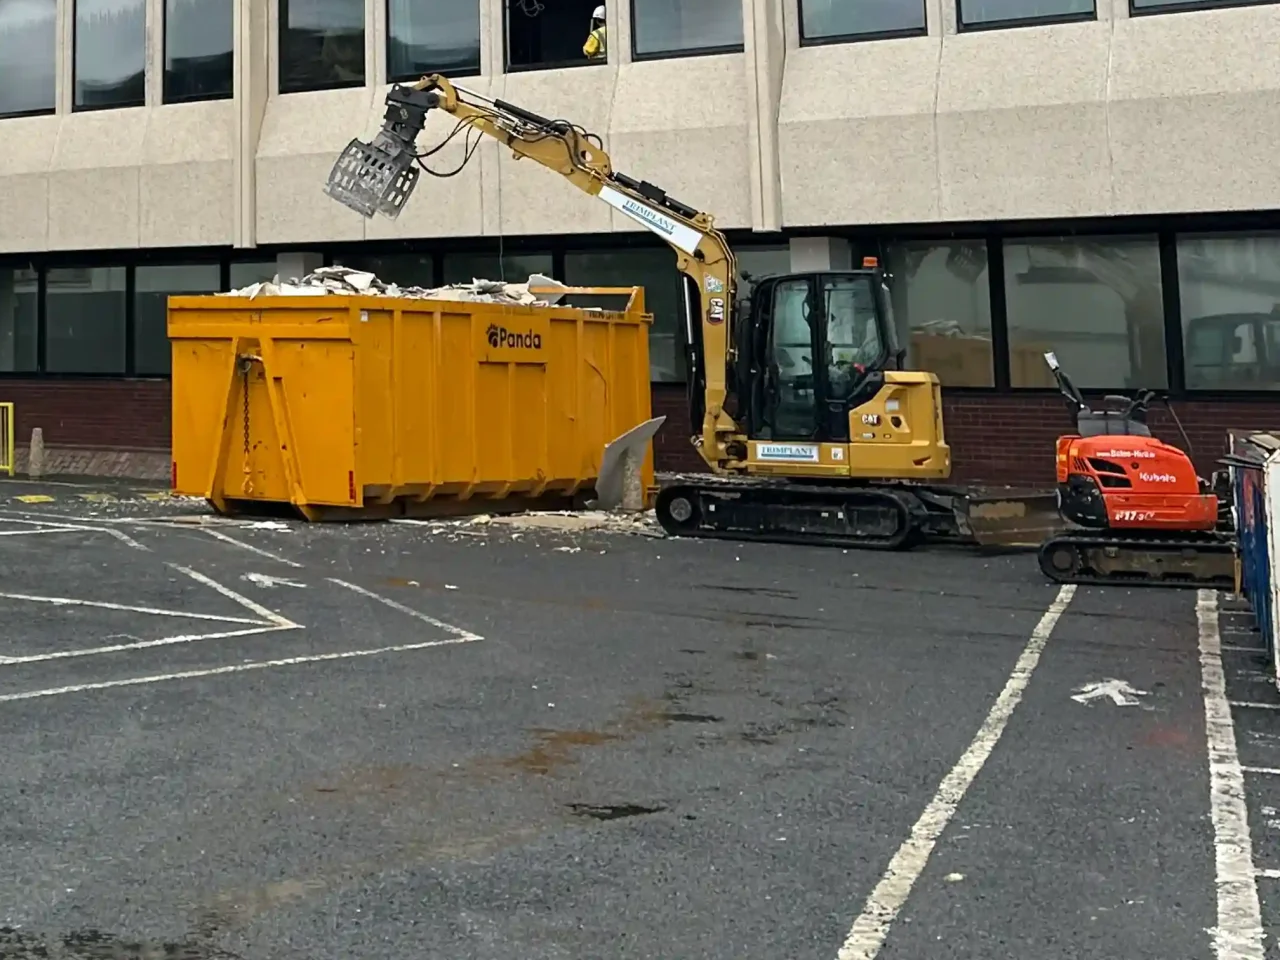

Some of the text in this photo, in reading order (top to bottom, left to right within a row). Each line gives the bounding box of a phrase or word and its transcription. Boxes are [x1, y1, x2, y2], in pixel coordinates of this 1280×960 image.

[499, 327, 542, 349] Panda
[861, 414, 878, 425] CAT
[761, 445, 814, 455] TRIMPLANT
[1139, 472, 1177, 483] Kubota
